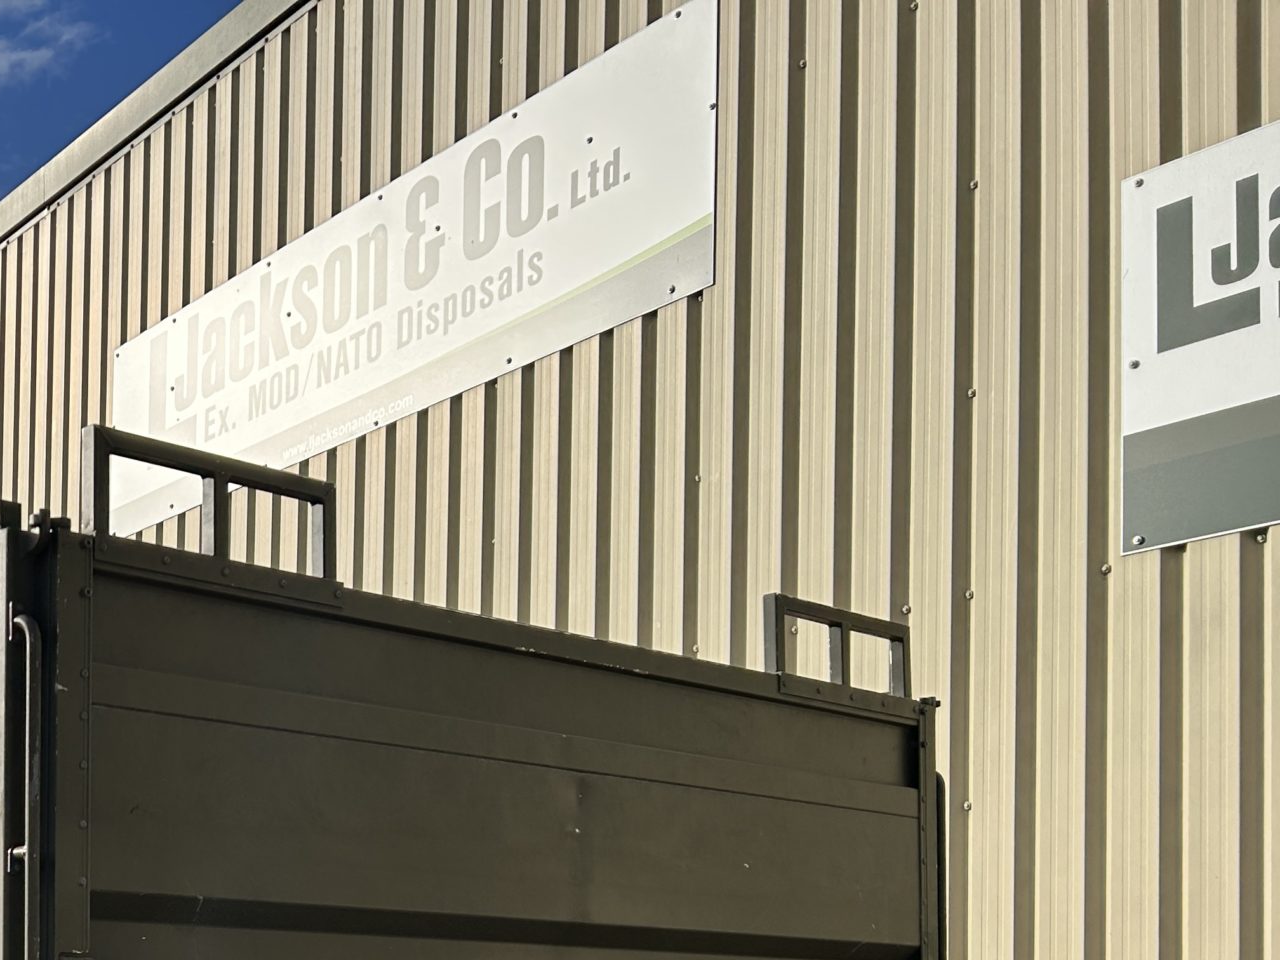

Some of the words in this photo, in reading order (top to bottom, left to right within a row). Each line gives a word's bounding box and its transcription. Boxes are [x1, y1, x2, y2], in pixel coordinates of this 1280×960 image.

[174, 223, 389, 412] Jackson
[404, 175, 446, 291] &
[570, 146, 631, 209] Ltd.
[1211, 173, 1280, 286] J
[204, 404, 237, 442] Ex.
[247, 321, 383, 422] MOD/NATO
[396, 248, 544, 351] Disposals
